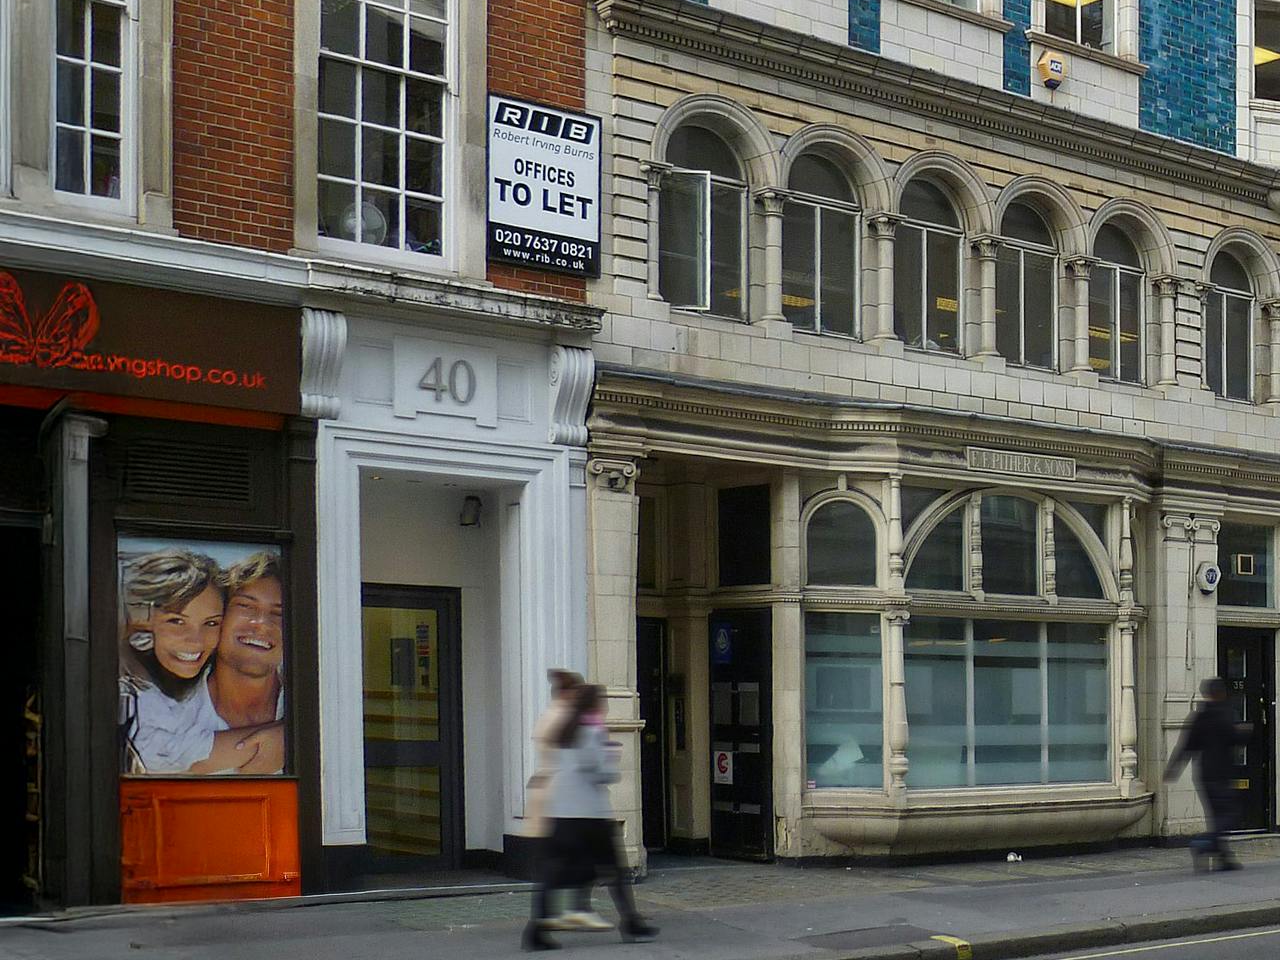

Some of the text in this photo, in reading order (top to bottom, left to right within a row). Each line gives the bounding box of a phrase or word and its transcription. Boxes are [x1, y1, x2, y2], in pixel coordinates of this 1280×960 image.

[502, 106, 588, 141] RIB
[493, 128, 594, 160] Robert Irving Burns
[514, 158, 575, 187] OFFICES
[494, 176, 593, 220] TO LET
[495, 229, 592, 259] 020 7637 0821
[503, 248, 585, 270] www.rib.co.uk
[418, 356, 477, 406] 40
[1044, 458, 1072, 477] SONS
